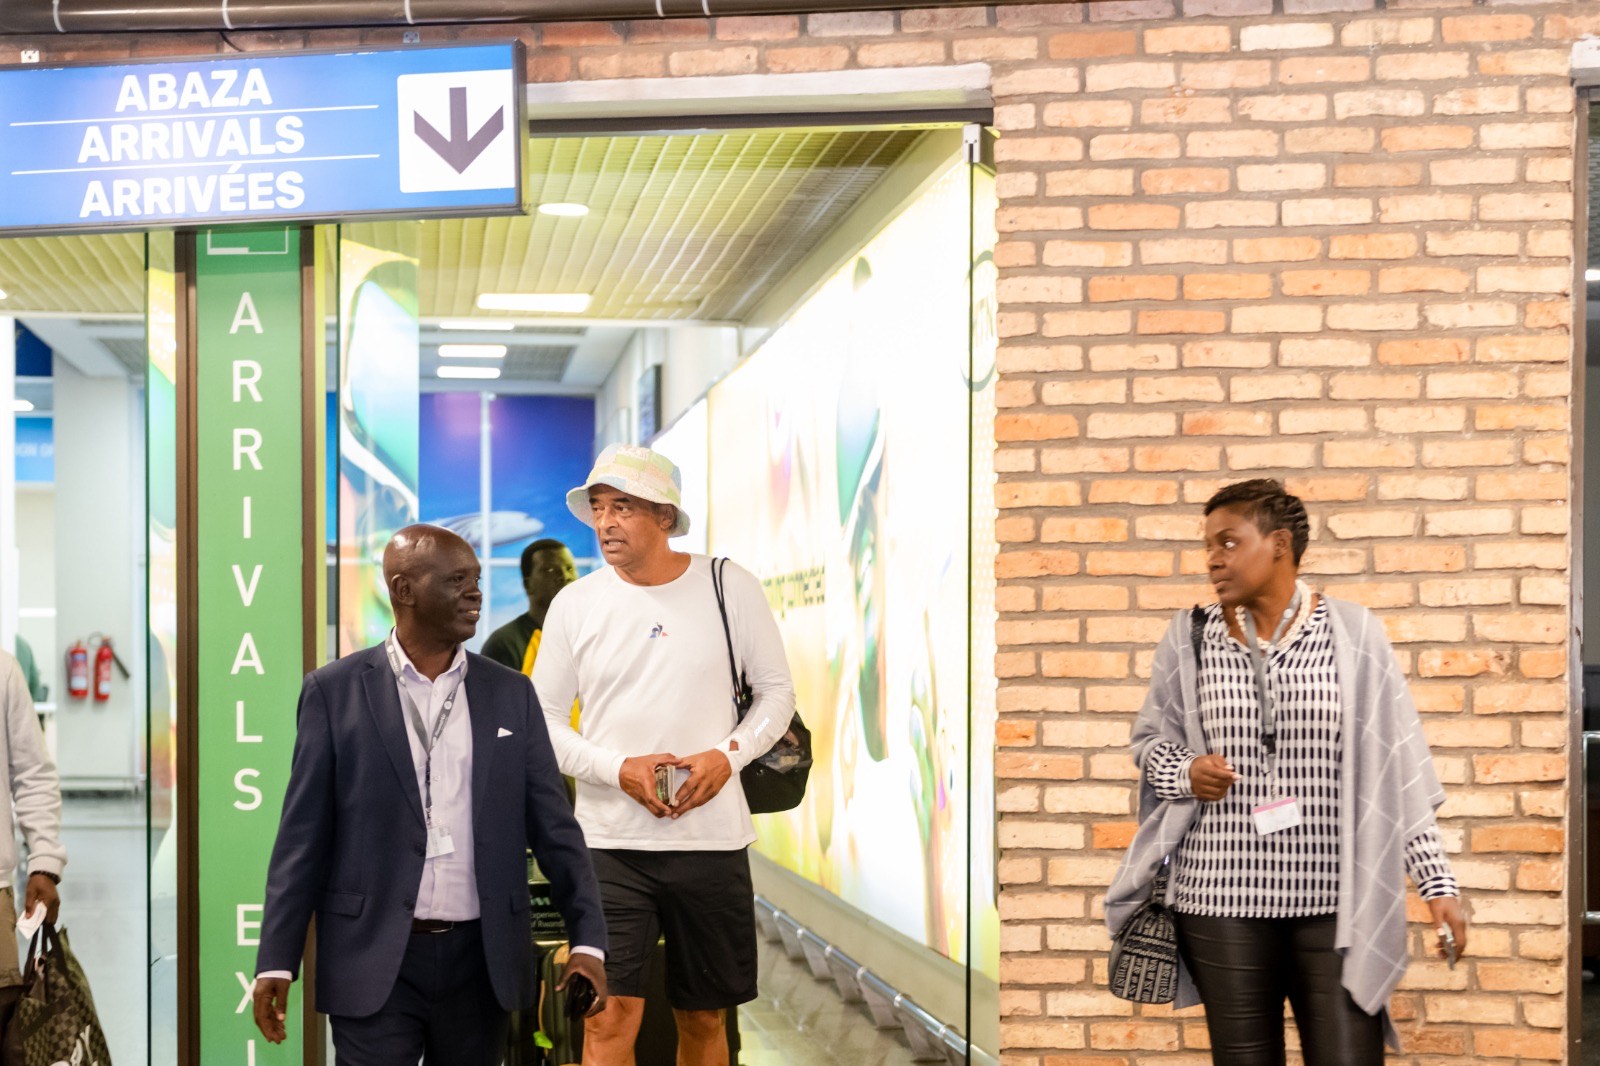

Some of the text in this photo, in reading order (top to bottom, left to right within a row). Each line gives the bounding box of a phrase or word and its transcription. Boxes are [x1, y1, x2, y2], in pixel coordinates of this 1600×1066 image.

[115, 68, 273, 112] ABAZA
[77, 115, 305, 163] ARRIVALS
[79, 164, 305, 217] ARRIVÉES
[229, 292, 264, 811] ARRIVALS
